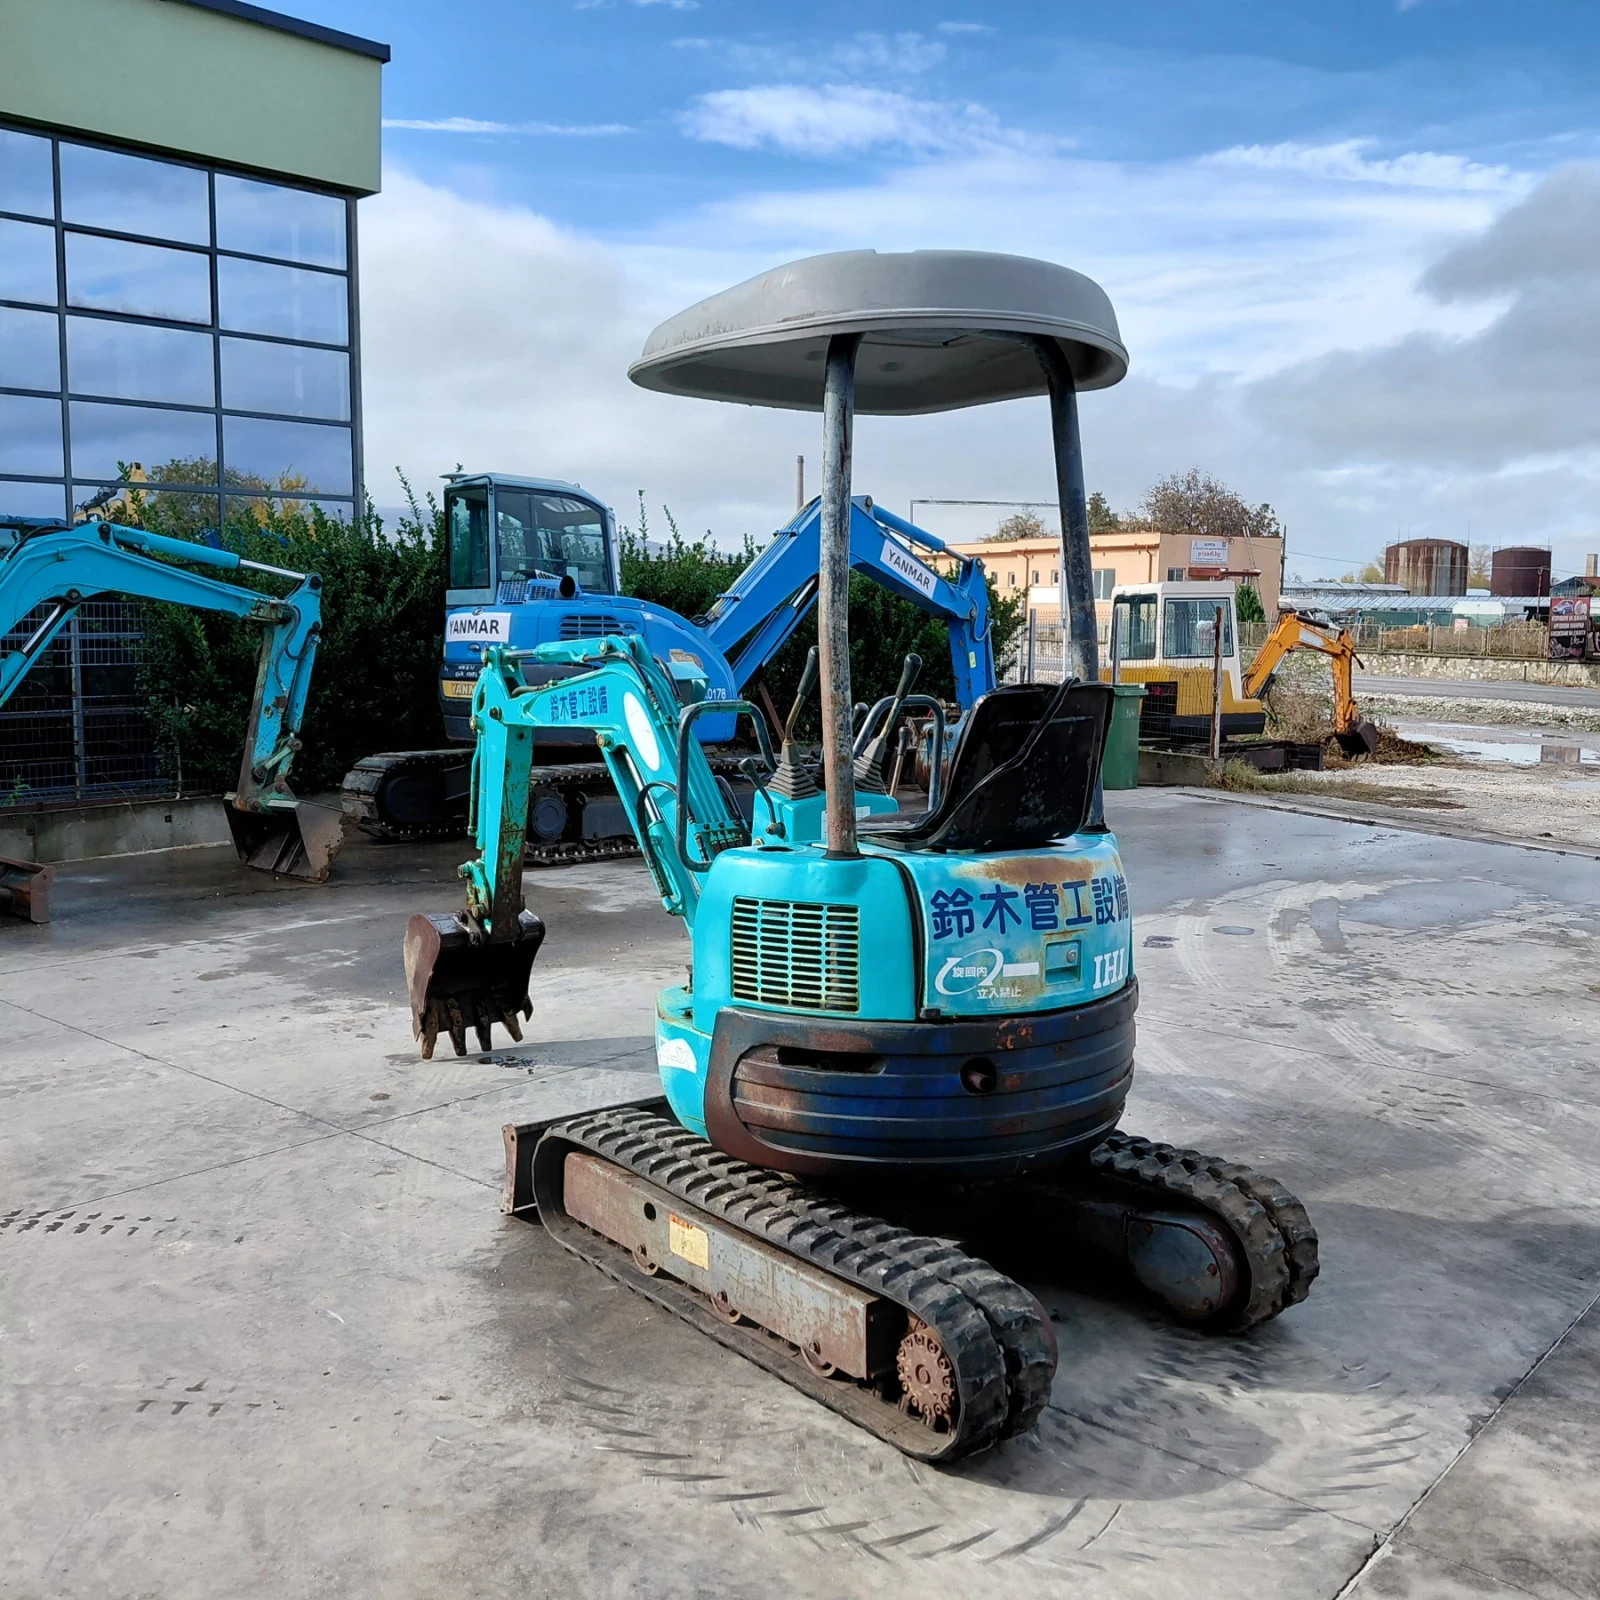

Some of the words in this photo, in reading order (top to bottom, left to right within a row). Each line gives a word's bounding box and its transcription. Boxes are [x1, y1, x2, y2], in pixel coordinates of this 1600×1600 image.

[888, 549, 930, 590] YANMAR
[449, 619, 500, 635] YANMAR
[550, 685, 608, 723] 鈴木管工設備
[930, 874, 1129, 941] 鈴木管工設備
[952, 966, 988, 978] 旋回内
[1092, 947, 1125, 990] IHI
[977, 986, 1022, 999] 立入禁止
